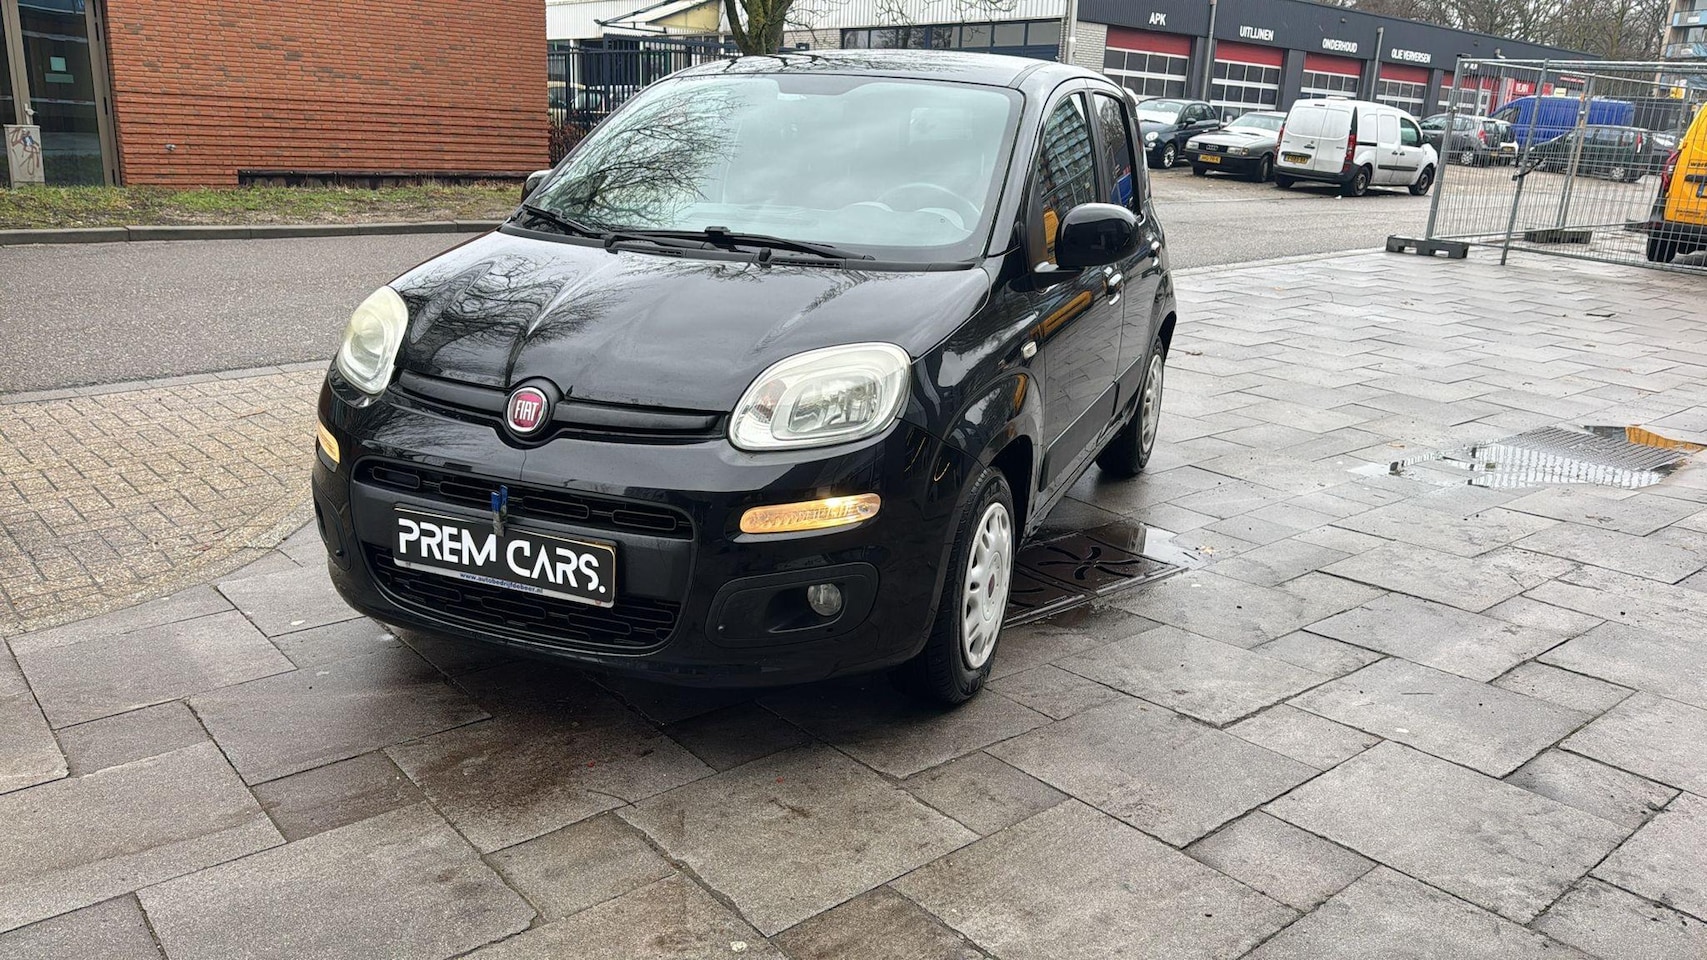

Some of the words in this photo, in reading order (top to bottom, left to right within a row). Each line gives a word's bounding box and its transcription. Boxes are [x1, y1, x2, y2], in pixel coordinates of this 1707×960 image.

[1149, 12, 1166, 26] APK
[1240, 25, 1274, 41] UITLIJNEN
[1322, 38, 1358, 53] ONDERHOUD
[1404, 50, 1432, 63] VERVERSEN
[515, 399, 539, 421] FIAT
[398, 518, 497, 567] PREM
[505, 540, 607, 594] CARS.
[459, 572, 544, 594] www.autobedrijfdebeer.nl
